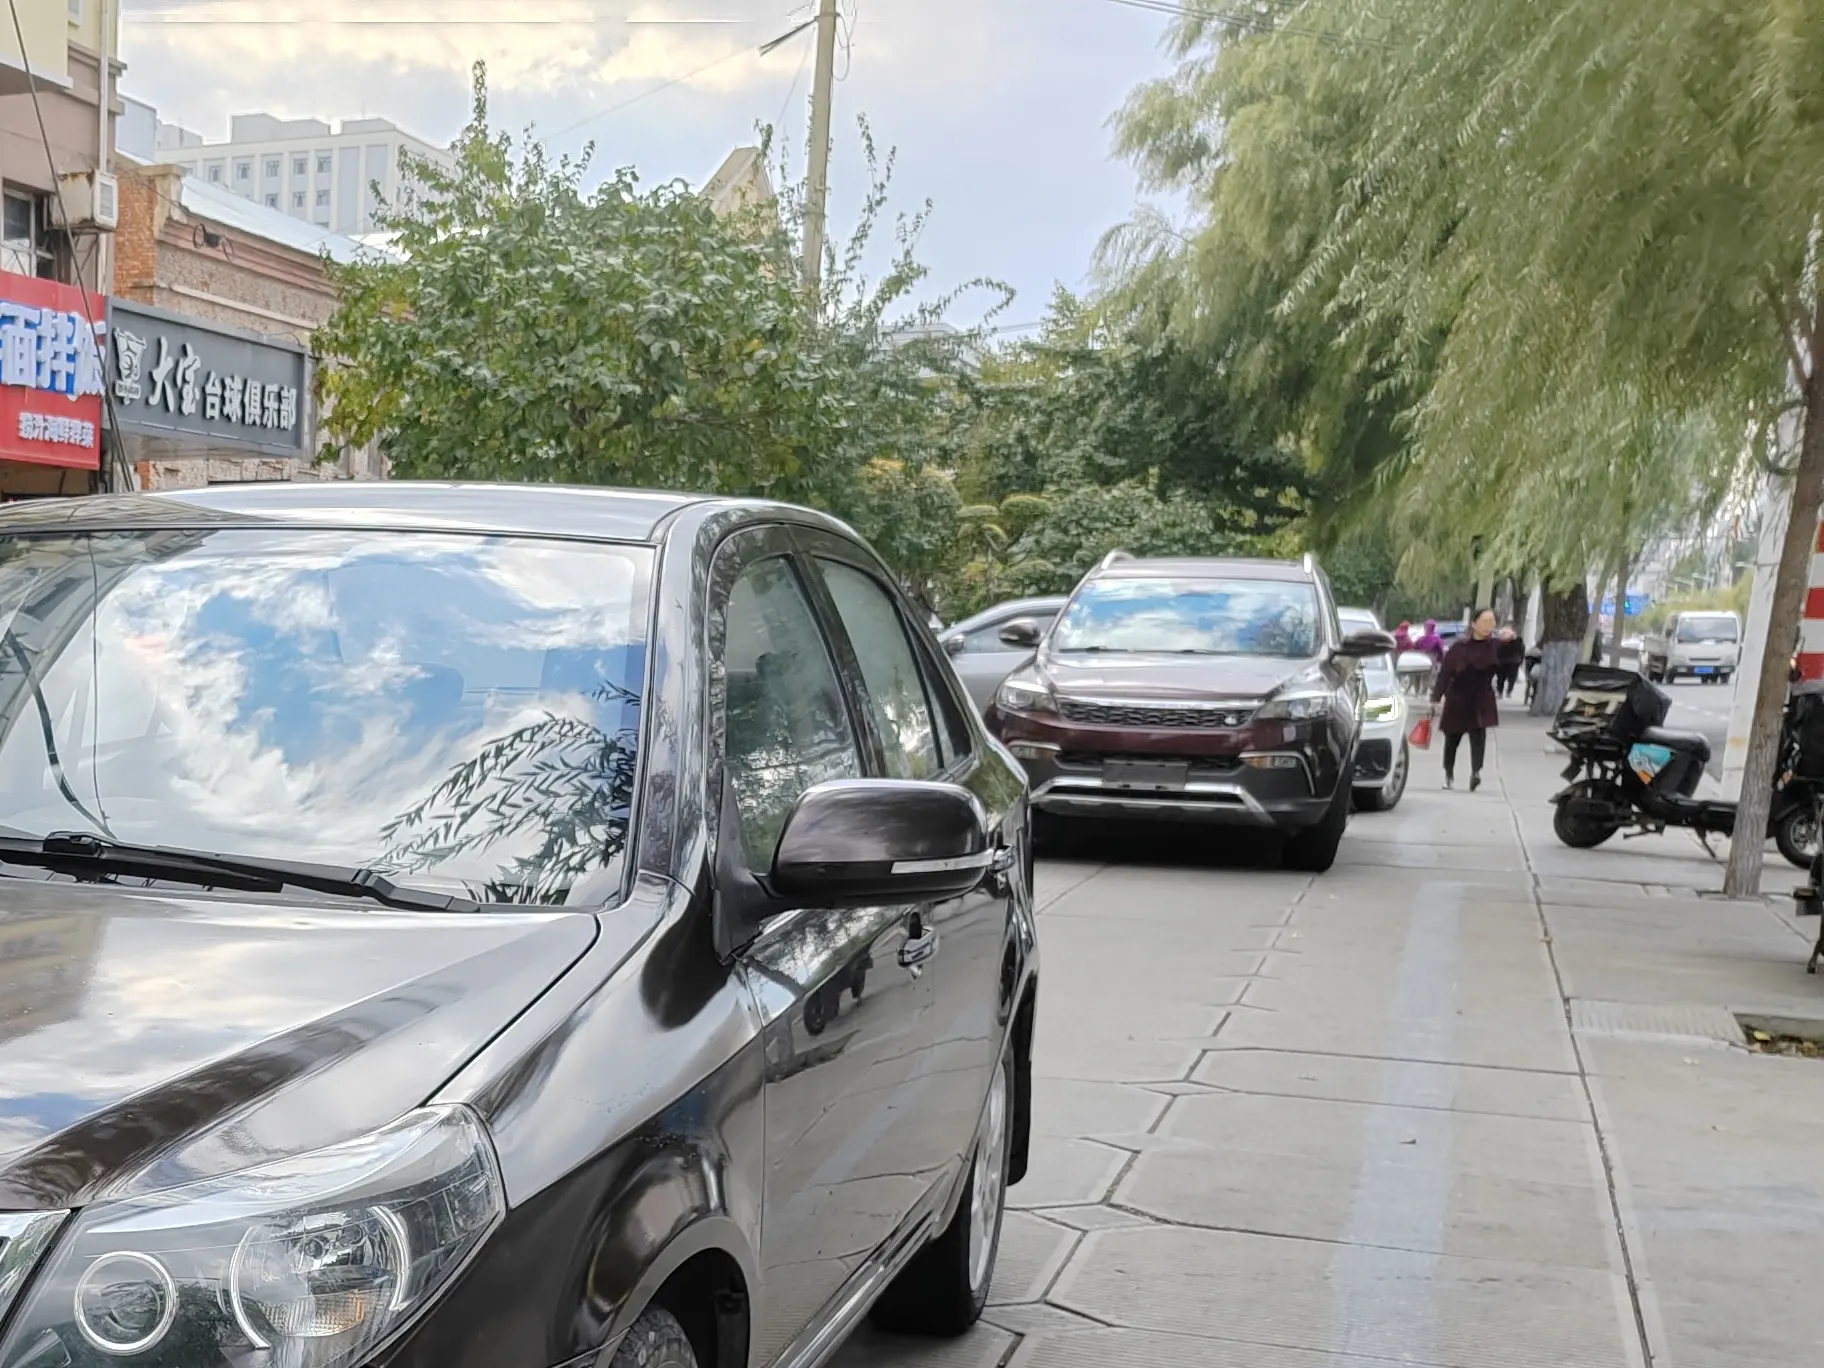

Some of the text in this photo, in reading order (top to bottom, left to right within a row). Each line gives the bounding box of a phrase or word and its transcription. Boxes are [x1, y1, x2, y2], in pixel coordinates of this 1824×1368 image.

[148, 336, 297, 431] 大宝台球俱乐部
